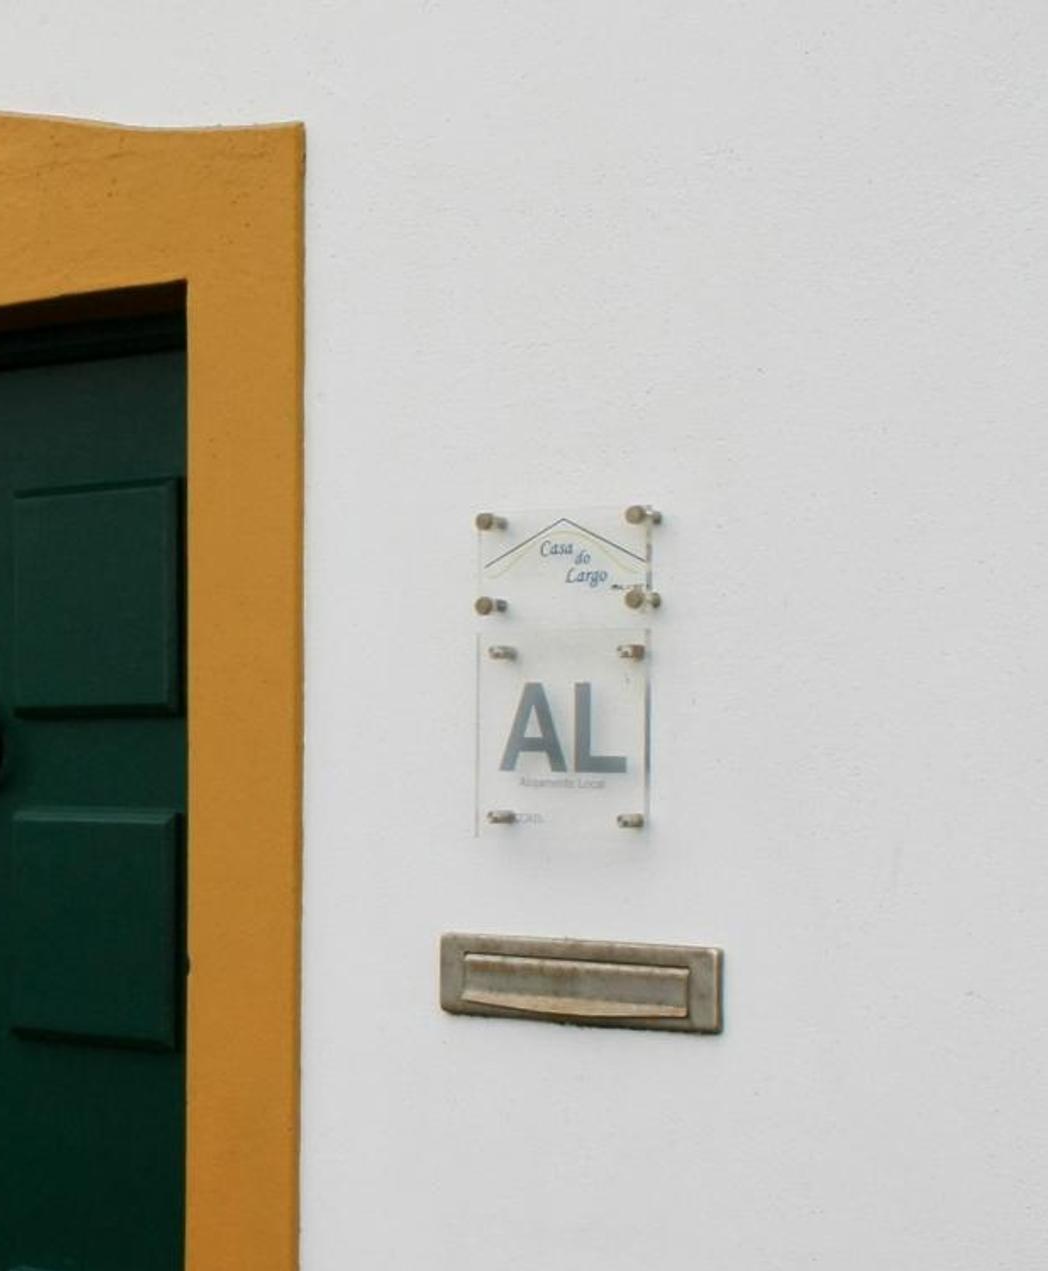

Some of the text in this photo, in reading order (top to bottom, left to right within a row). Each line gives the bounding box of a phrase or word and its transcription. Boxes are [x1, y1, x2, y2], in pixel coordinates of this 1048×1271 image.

[540, 540, 573, 557] Casa
[574, 550, 591, 565] do
[565, 567, 608, 588] Largo
[499, 682, 626, 773] AL
